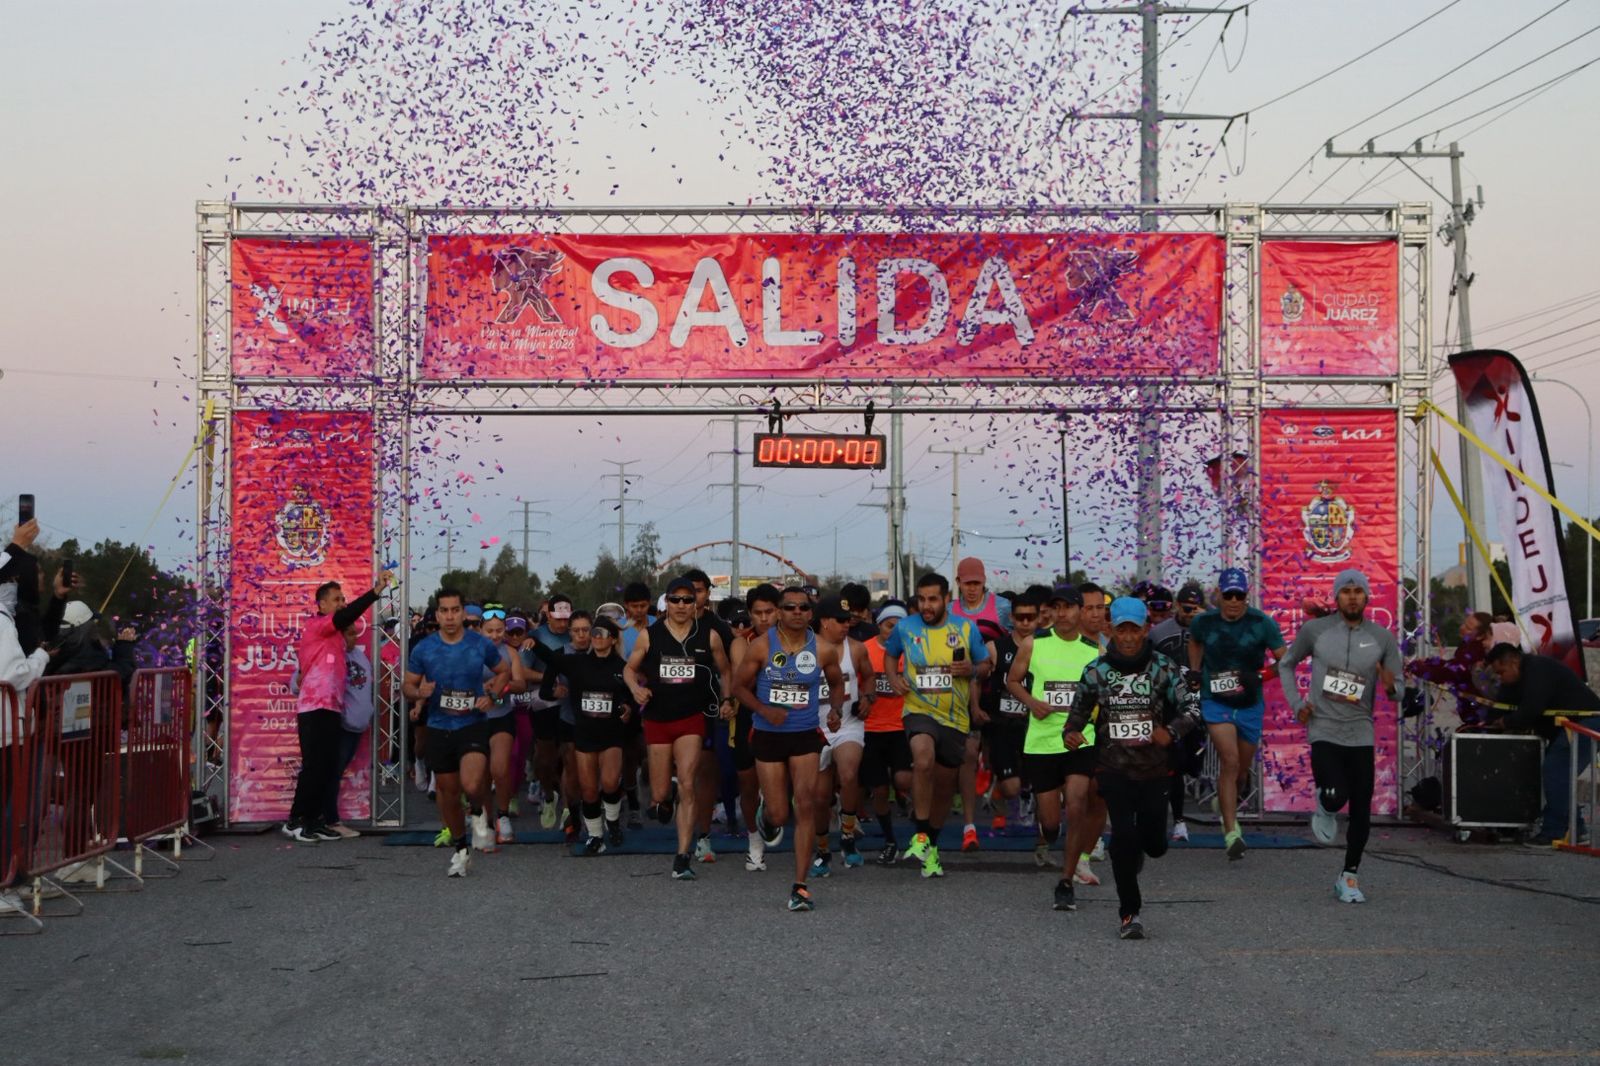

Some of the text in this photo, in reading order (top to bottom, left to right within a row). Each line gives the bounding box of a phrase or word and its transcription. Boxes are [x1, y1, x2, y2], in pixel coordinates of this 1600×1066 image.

[590, 256, 1035, 347] SALIDA
[1323, 293, 1378, 307] CIUDAD
[1323, 305, 1378, 320] JUÁREZ
[662, 665, 694, 677] 1685
[918, 675, 951, 687] 1120
[1329, 679, 1358, 695] 429
[773, 690, 807, 702] 1315
[1046, 692, 1070, 704] 161
[445, 697, 470, 709] 835
[583, 700, 609, 711] 1331
[1111, 722, 1151, 737] 1958
